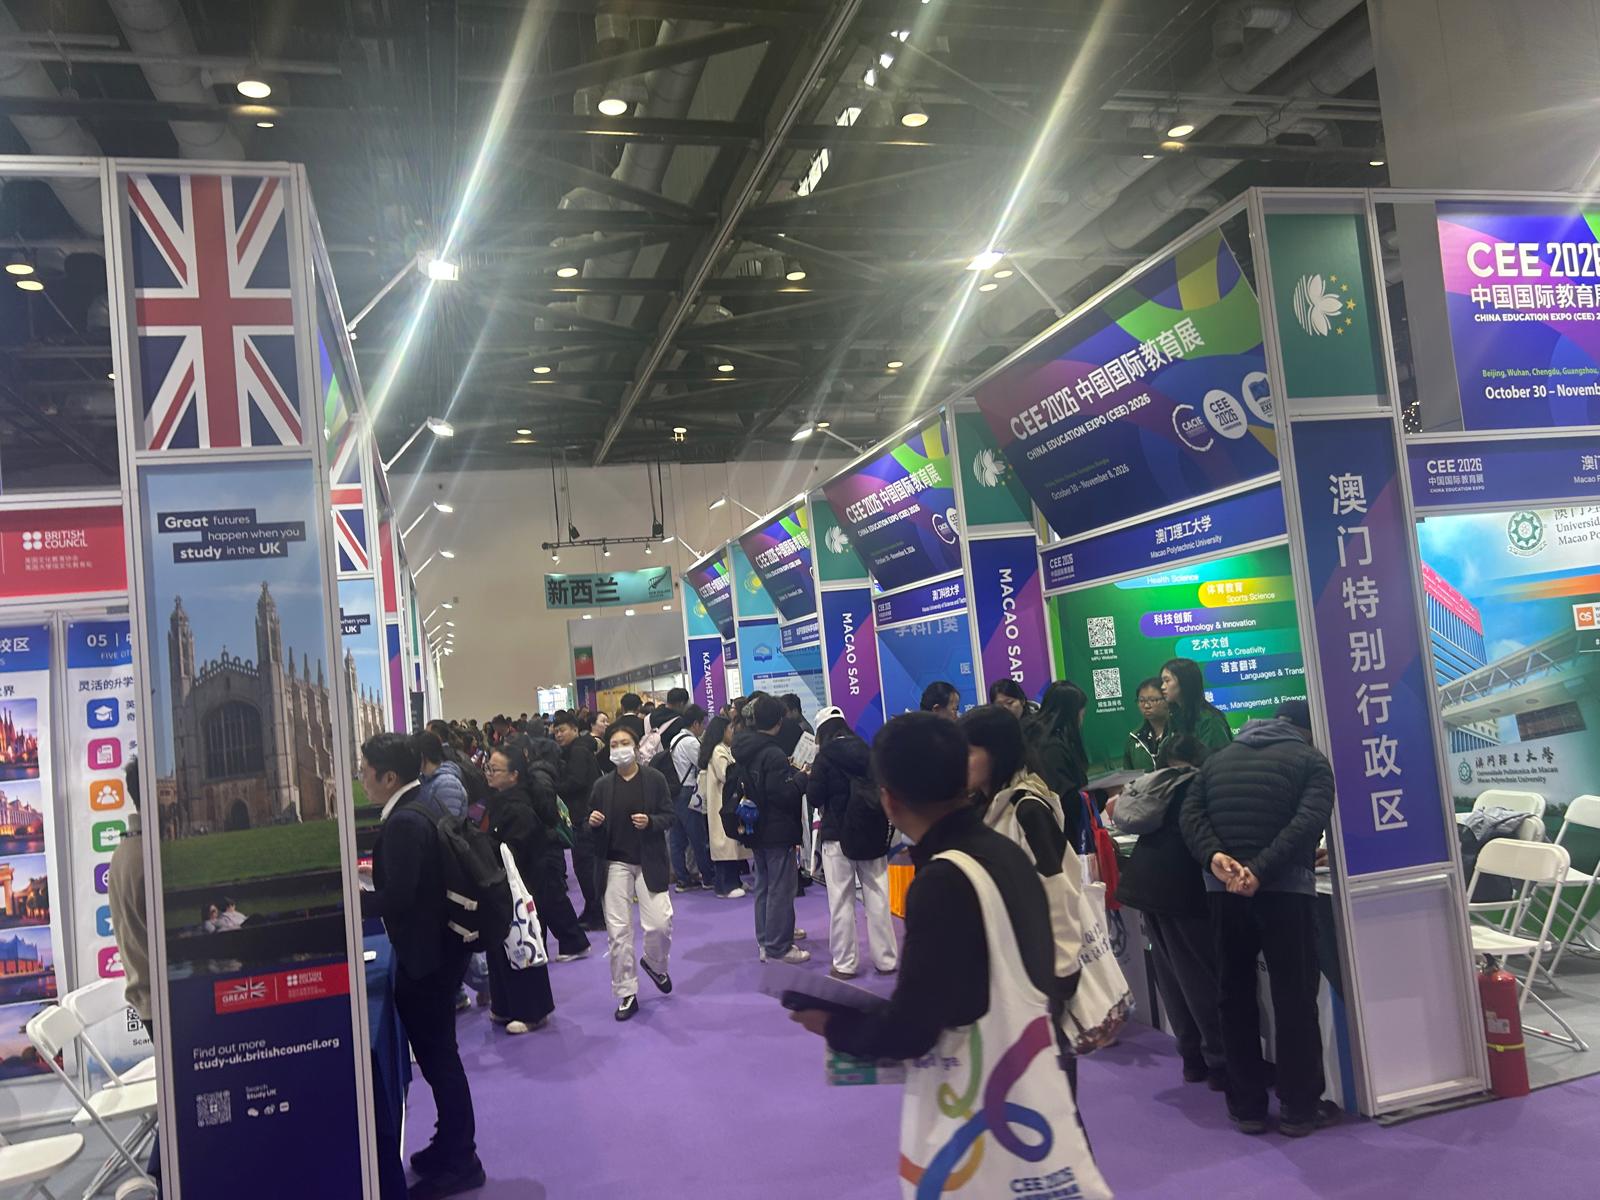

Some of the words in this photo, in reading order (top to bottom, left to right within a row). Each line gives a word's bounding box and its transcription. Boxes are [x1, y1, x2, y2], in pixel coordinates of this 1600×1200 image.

[1466, 242, 1542, 278] CEE
[1470, 283, 1600, 310] 中国国际教育
[1474, 313, 1501, 322] CHINA
[1502, 312, 1549, 321] EDUCATION
[1550, 312, 1573, 321] EXPO
[1574, 312, 1596, 322] (CEE)
[1010, 404, 1049, 440] CEE
[1042, 386, 1081, 425] 2026
[1074, 317, 1205, 405] 中国国际教育展
[1482, 369, 1507, 379] Beijing,
[1507, 368, 1532, 377] Wuhan,
[1532, 367, 1561, 378] Chengdu,
[1485, 385, 1531, 399] October
[1532, 384, 1547, 398] 30
[1556, 382, 1600, 397] Novemb
[1209, 397, 1231, 413] CEE
[1215, 408, 1239, 426] 2026
[1026, 444, 1049, 461] CHINA
[1046, 424, 1086, 451] EDUCATION
[1084, 415, 1107, 432] EXPO
[1106, 404, 1130, 423] (CEE)
[1127, 393, 1152, 412] 2026
[1112, 463, 1130, 478] 2026
[1426, 459, 1456, 474] CEE
[1457, 457, 1483, 473] 2026
[1428, 473, 1484, 486] 中国国际教育展
[1573, 474, 1597, 484] Macao
[845, 502, 868, 524] CEE
[862, 492, 884, 517] 2026
[164, 516, 209, 529] Great
[213, 515, 251, 526] futures
[1155, 514, 1213, 545] 澳门理工大学
[44, 529, 85, 541] BRITISH
[207, 531, 249, 542] happen
[250, 528, 279, 539] when
[280, 529, 300, 538] you
[1558, 534, 1589, 546] Macao
[44, 538, 89, 550] COUNCIL
[180, 545, 222, 560] study
[226, 545, 236, 555] in
[237, 544, 256, 554] the
[259, 541, 281, 555] UK
[1166, 541, 1196, 556] Polytechnic
[1195, 534, 1223, 549] University
[1050, 555, 1063, 570] CEE
[1147, 575, 1170, 586] Health
[1171, 573, 1200, 584] Science
[546, 576, 621, 606] 新西兰
[1249, 591, 1276, 601] Science
[998, 567, 1021, 641] MACAO
[1153, 611, 1193, 626] 科技创新
[1175, 622, 1215, 634] Technology
[1215, 621, 1223, 629] &
[1222, 618, 1257, 628] Innovation
[344, 625, 358, 633] UK
[86, 633, 108, 648] 05
[842, 612, 857, 665] MACAO
[1191, 636, 1230, 651] 艺术文创
[1211, 650, 1227, 658] Arts
[1227, 649, 1234, 657] &
[1234, 645, 1267, 657] Creativity
[1328, 472, 1408, 832] 澳门特别行政区
[1007, 644, 1024, 683] SAR
[1220, 659, 1258, 674] 语言翻译
[702, 651, 716, 713] KAZAKHSTAN
[847, 666, 860, 696] SAR
[1240, 670, 1277, 681] Languages
[1277, 668, 1284, 677] &
[78, 676, 134, 692] 灵活的升学
[1230, 698, 1273, 709] Management
[1273, 696, 1280, 704] &
[193, 1046, 216, 1060] Find
[218, 1043, 236, 1055] out
[238, 1039, 267, 1051] more
[193, 1037, 341, 1071] study-uk.britishcouncil.org
[1009, 1177, 1044, 1193] CEE
